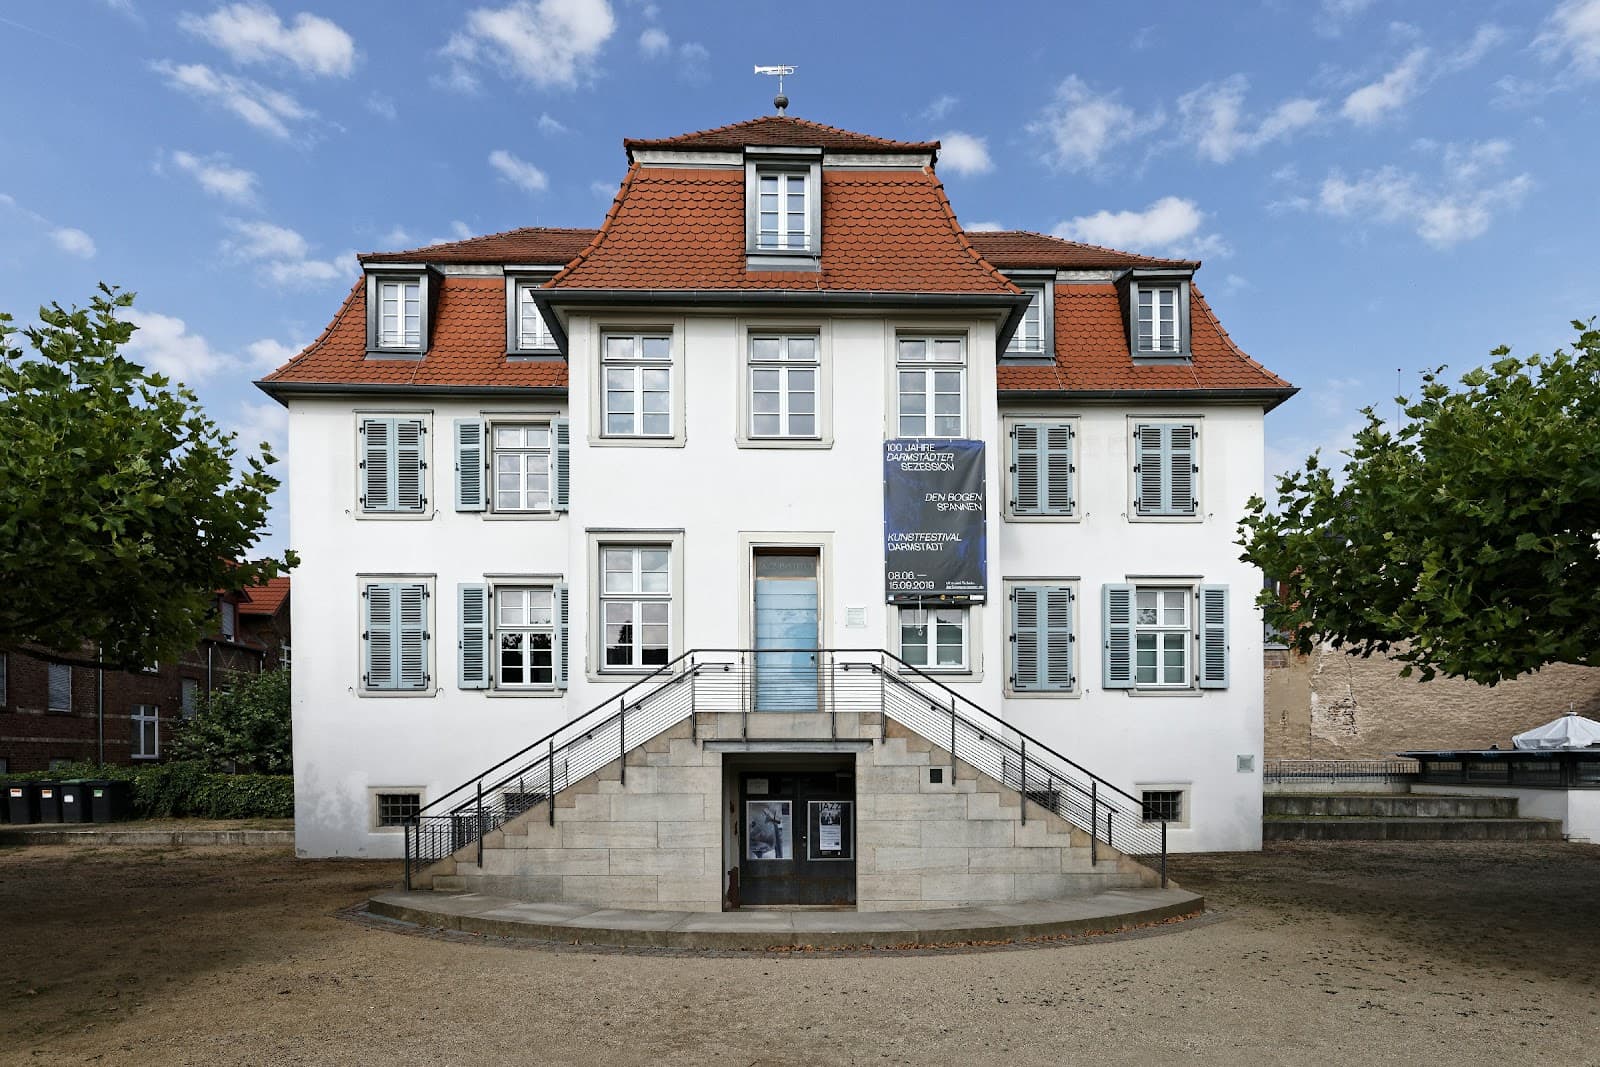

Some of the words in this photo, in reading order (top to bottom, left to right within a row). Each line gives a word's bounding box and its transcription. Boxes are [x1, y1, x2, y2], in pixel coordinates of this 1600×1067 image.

[887, 443, 902, 451] 100
[905, 443, 935, 451] JAHRE
[886, 452, 954, 461] DARMSTÄDTER
[901, 462, 955, 471] SEZESSION
[925, 493, 946, 501] DEN
[947, 493, 983, 501] BOGEN
[936, 503, 983, 511] SPANNEN
[887, 532, 962, 542] KUNSTFESTIVAL
[888, 543, 944, 551] DARMSTADT
[888, 581, 935, 590] 15.09.2019
